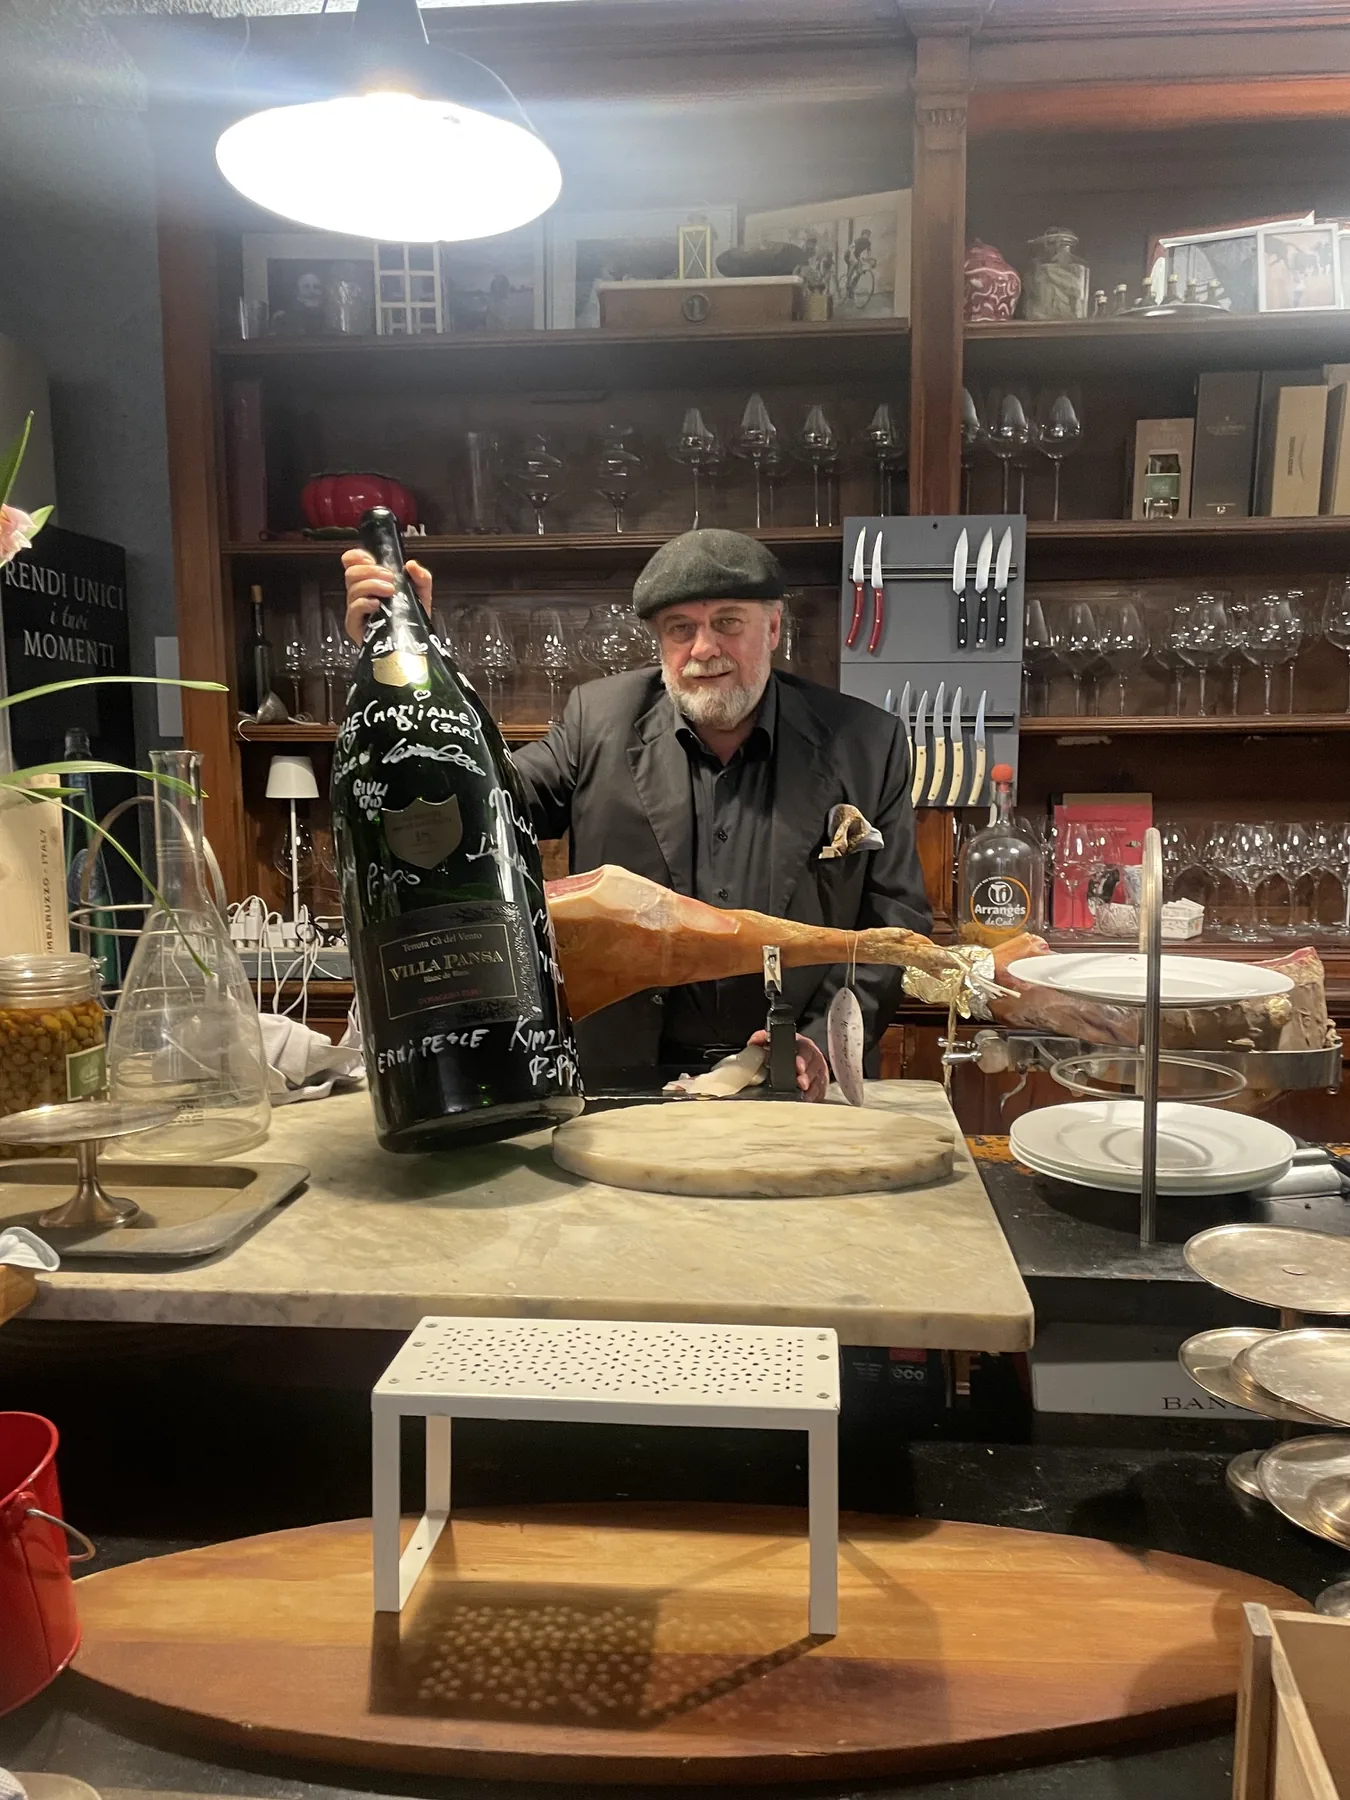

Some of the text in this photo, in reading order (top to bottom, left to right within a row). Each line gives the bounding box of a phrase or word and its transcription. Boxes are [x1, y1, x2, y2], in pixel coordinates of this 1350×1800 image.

[5, 561, 125, 611] RENDI UNICI
[50, 602, 57, 625] i
[23, 629, 116, 668] MOMENTI
[39, 829, 49, 865] ITALY
[974, 904, 1026, 918] Arrangés
[402, 940, 429, 953] Tenuta
[442, 932, 457, 944] del
[458, 932, 483, 942] Vento
[389, 949, 504, 983] VILLA PANSA
[1162, 1396, 1226, 1410] BAN
